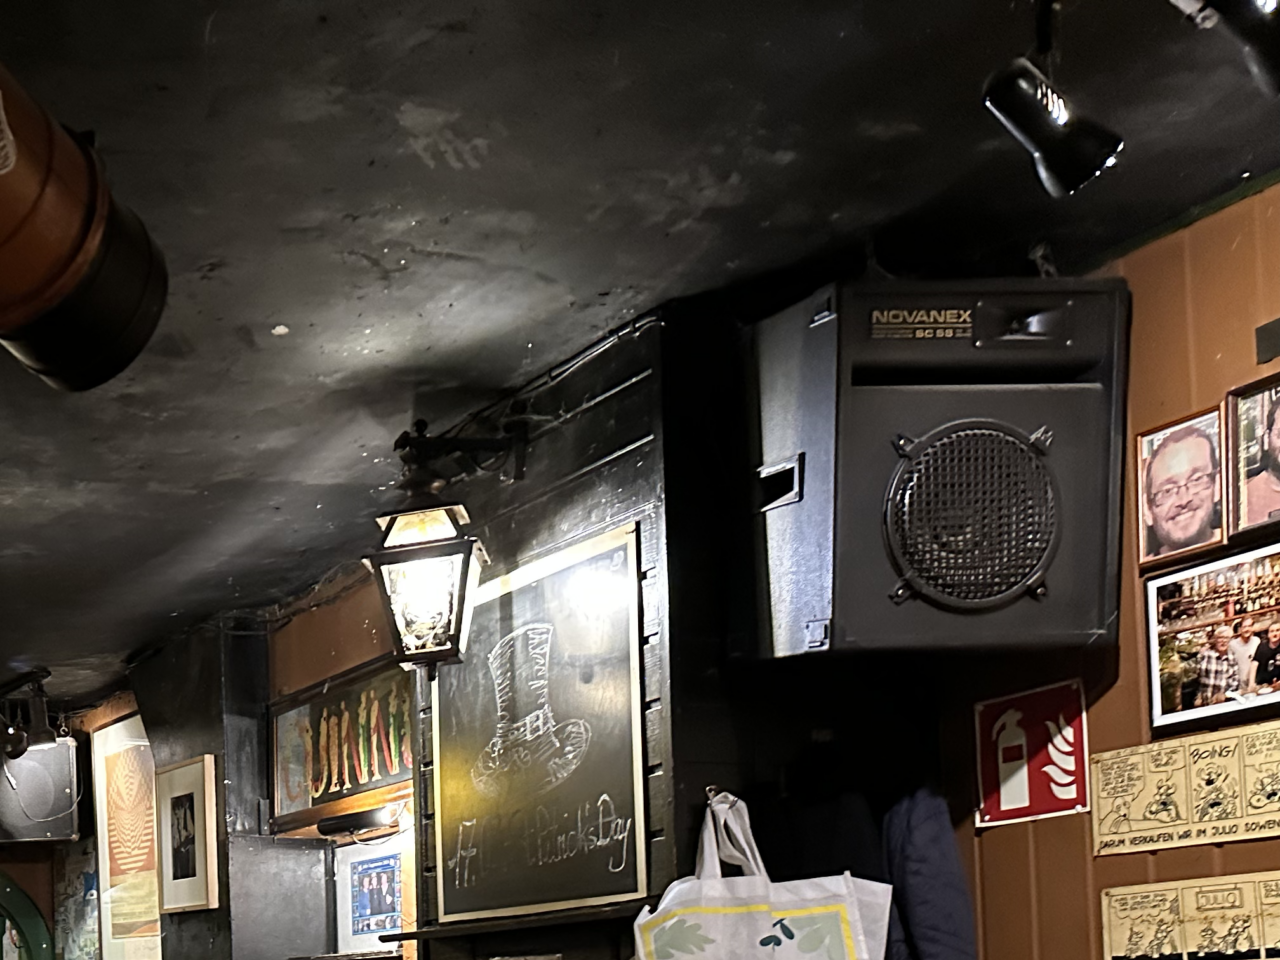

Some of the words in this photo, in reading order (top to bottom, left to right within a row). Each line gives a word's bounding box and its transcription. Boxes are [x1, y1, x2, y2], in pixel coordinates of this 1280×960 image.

[871, 309, 972, 324] NOVANEX
[915, 328, 934, 339] SC
[596, 793, 632, 873] Day
[1212, 824, 1238, 837] JULIO
